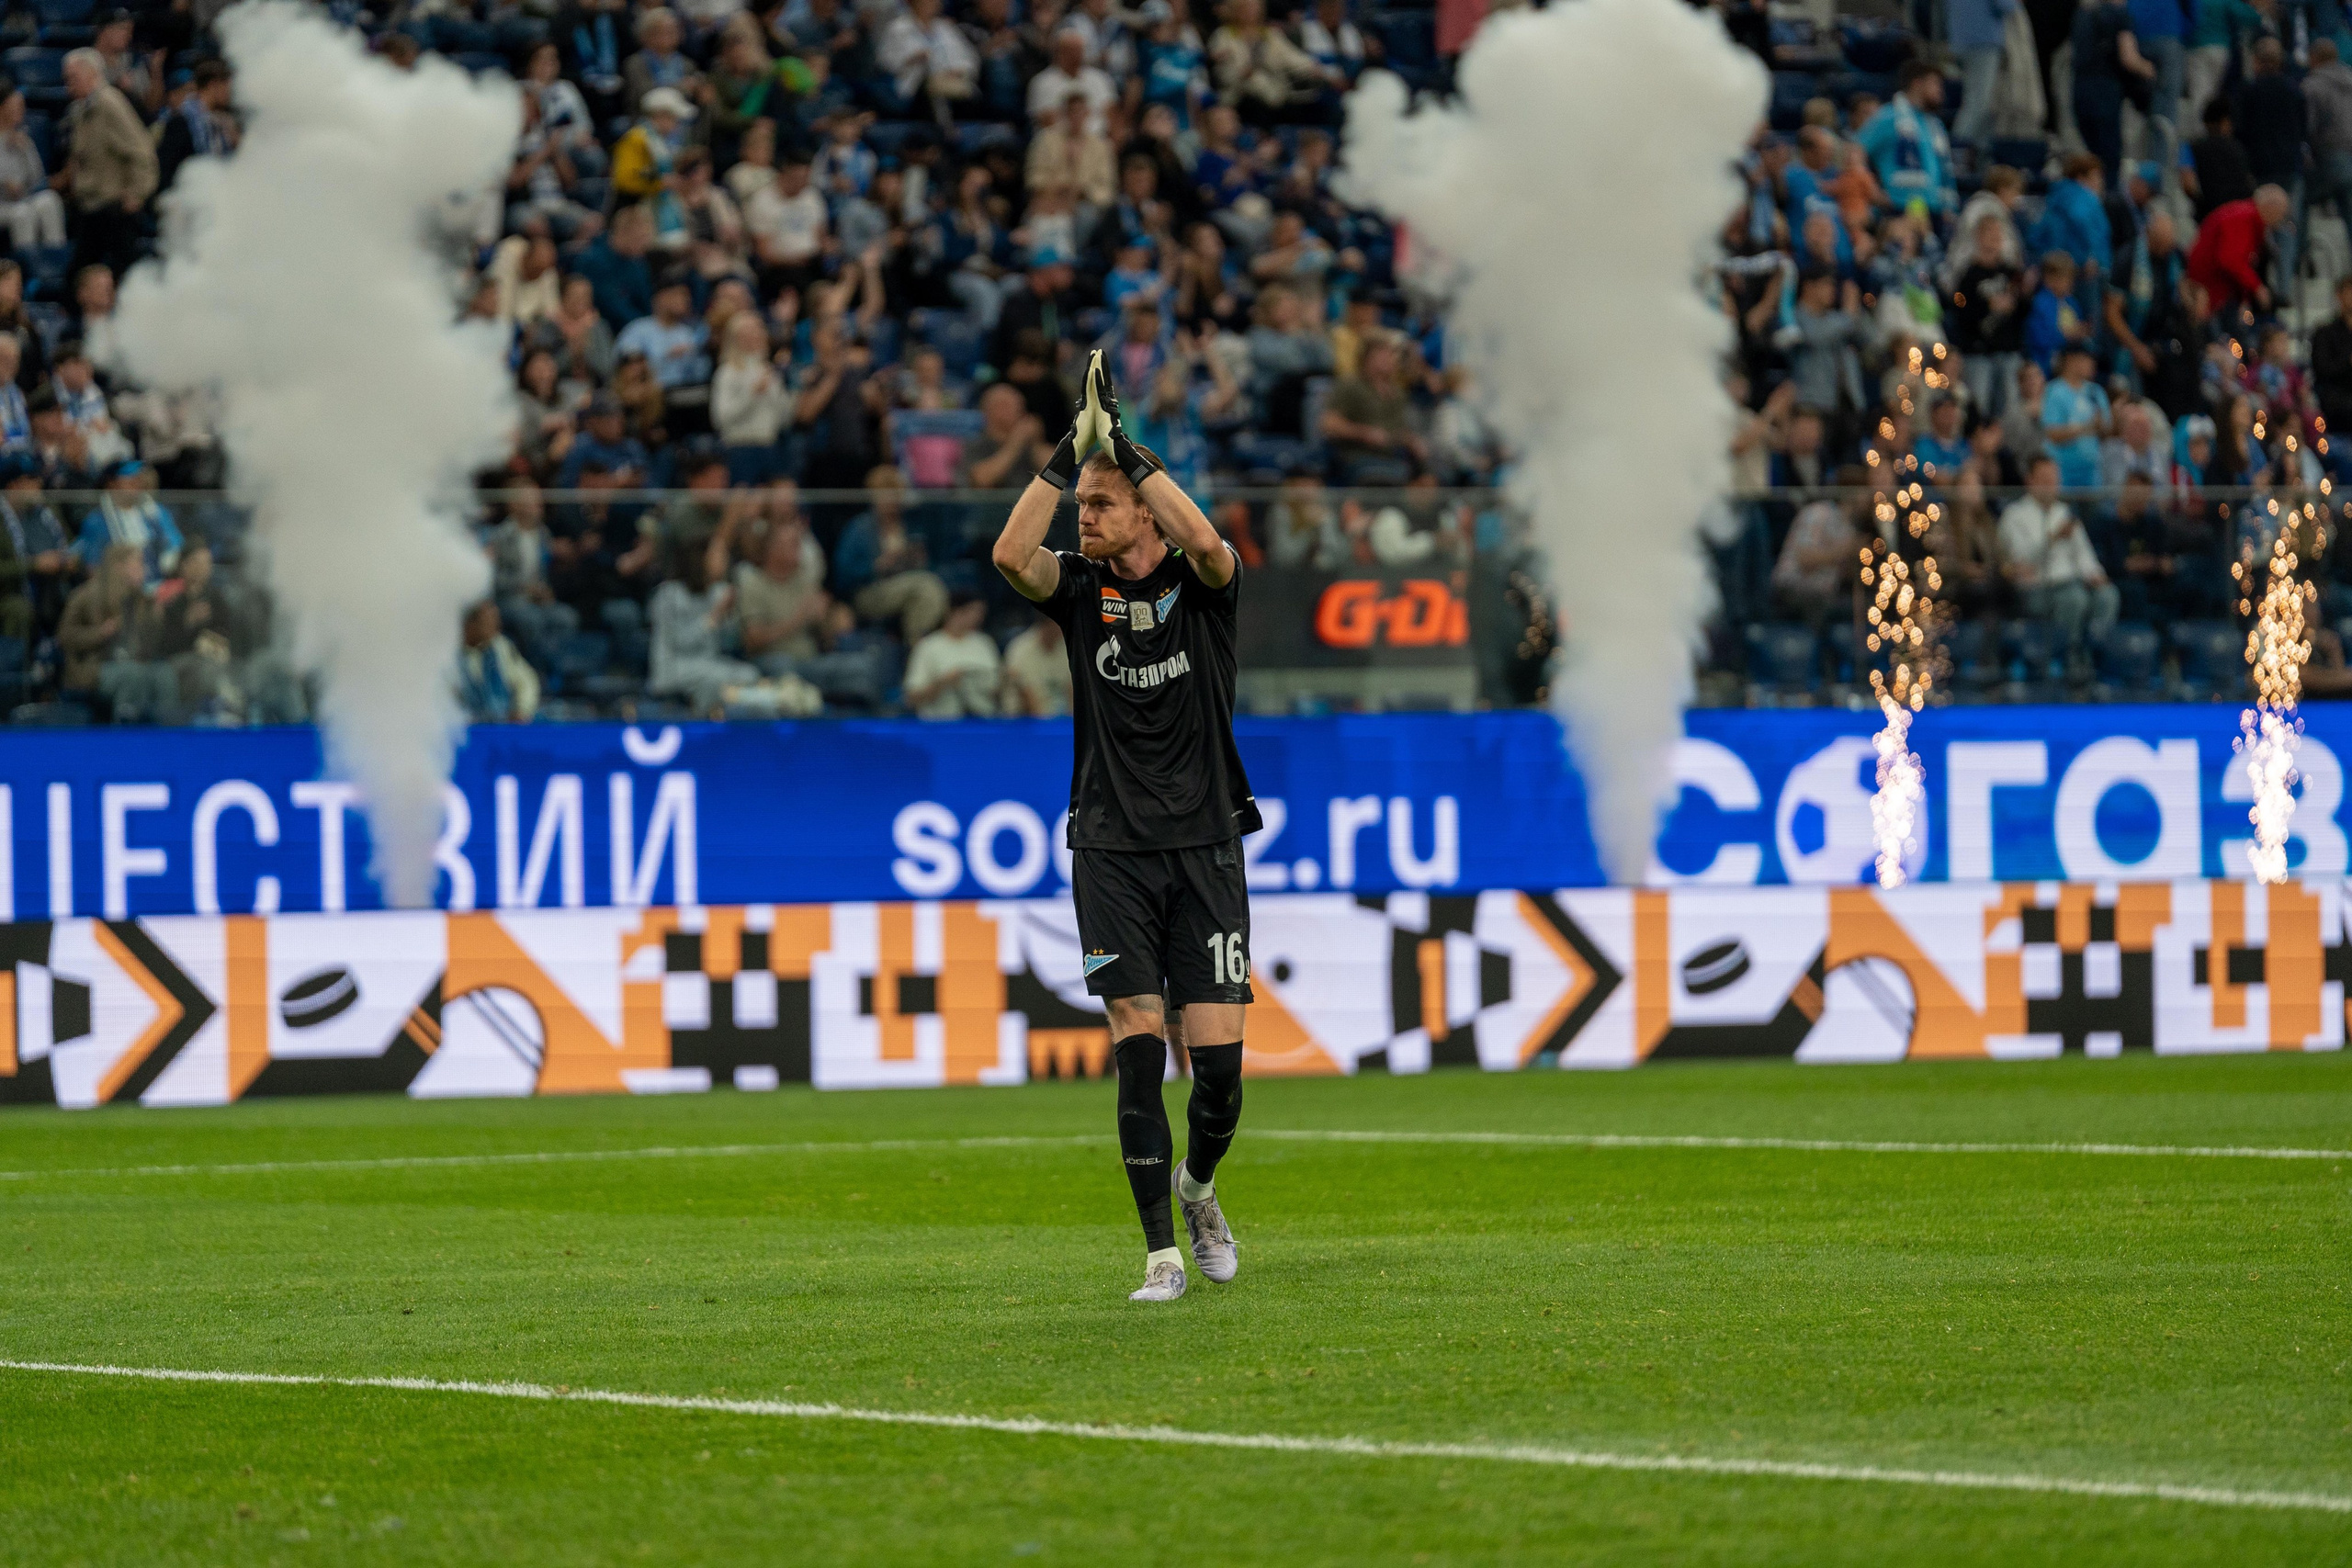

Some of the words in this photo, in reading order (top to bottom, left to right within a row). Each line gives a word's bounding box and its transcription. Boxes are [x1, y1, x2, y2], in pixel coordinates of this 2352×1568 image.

[1102, 601, 1127, 614] WIN
[1120, 651, 1191, 688] ГАЗПРОМ
[892, 795, 1460, 897] soz.ru
[1207, 932, 1245, 984] 16
